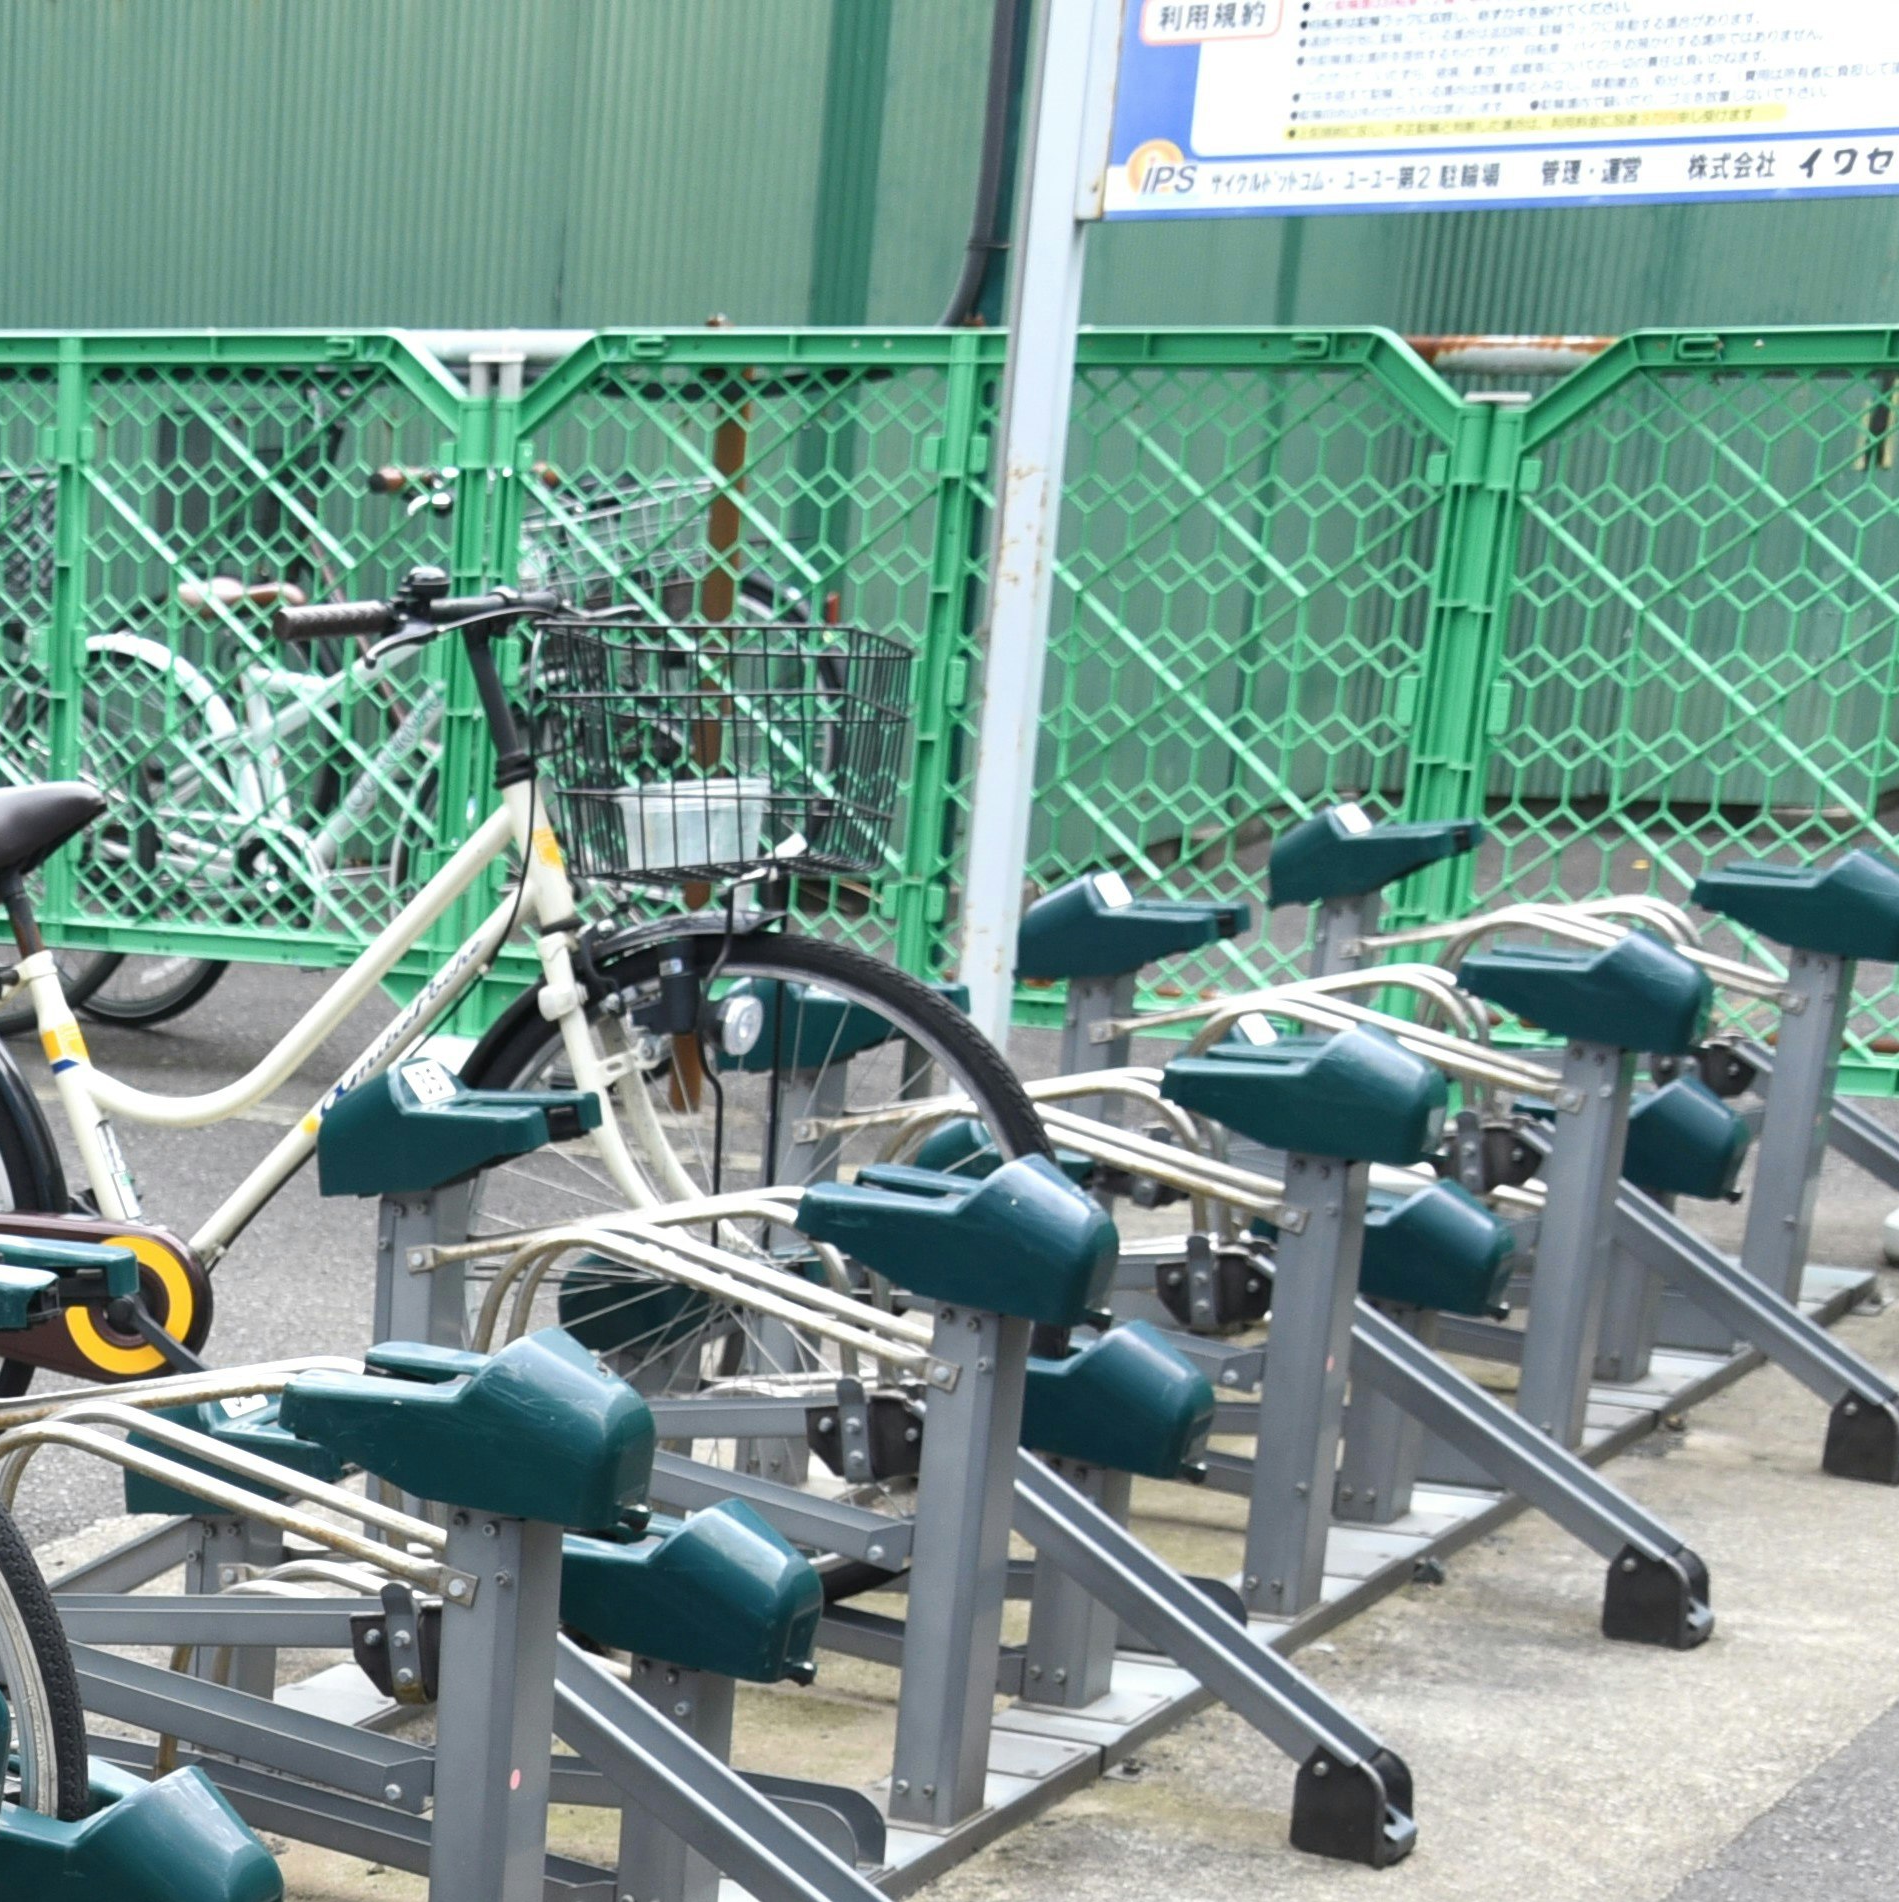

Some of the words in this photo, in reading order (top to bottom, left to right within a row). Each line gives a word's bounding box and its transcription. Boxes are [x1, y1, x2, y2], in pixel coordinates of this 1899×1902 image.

[1158, 1, 1265, 32] 利用規約
[1687, 151, 1776, 181] 株式会社
